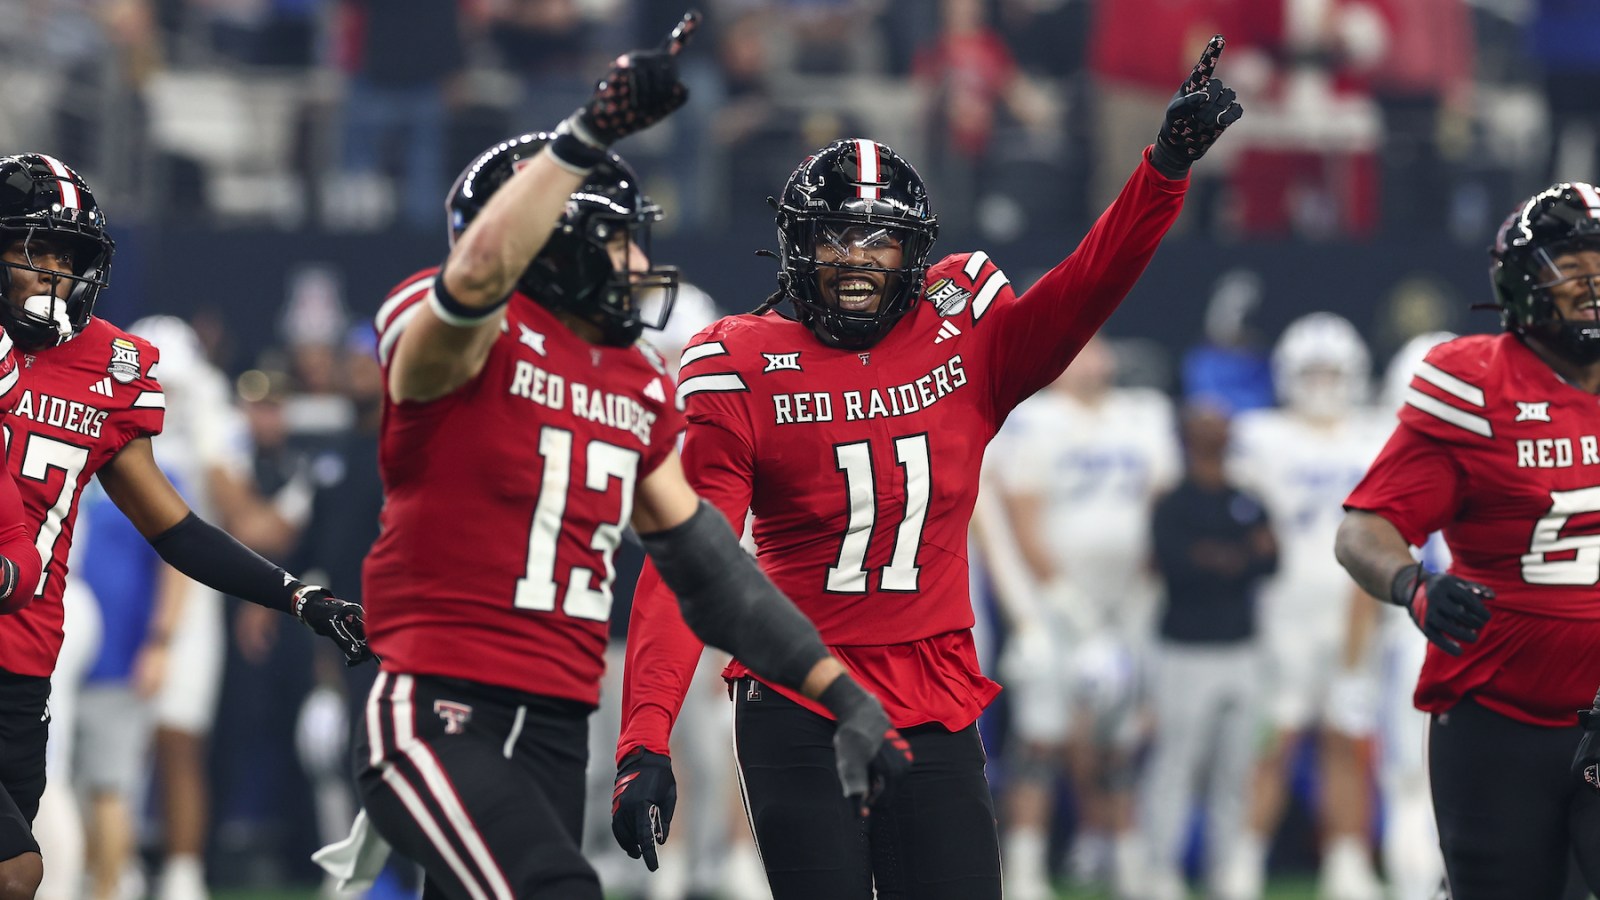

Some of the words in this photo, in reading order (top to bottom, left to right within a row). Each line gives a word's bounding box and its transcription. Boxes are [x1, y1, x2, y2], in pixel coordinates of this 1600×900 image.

[111, 345, 140, 369] XII
[762, 352, 802, 373] XII
[8, 389, 109, 439] AIDERS
[510, 360, 565, 411] RED
[570, 382, 657, 446] RAIDERS
[773, 391, 833, 424] RED
[843, 354, 968, 422] RAIDERS
[1515, 401, 1551, 422] XII
[1516, 438, 1573, 468] RED
[3, 424, 90, 598] 7
[513, 424, 641, 622] 13
[824, 432, 932, 594] 11
